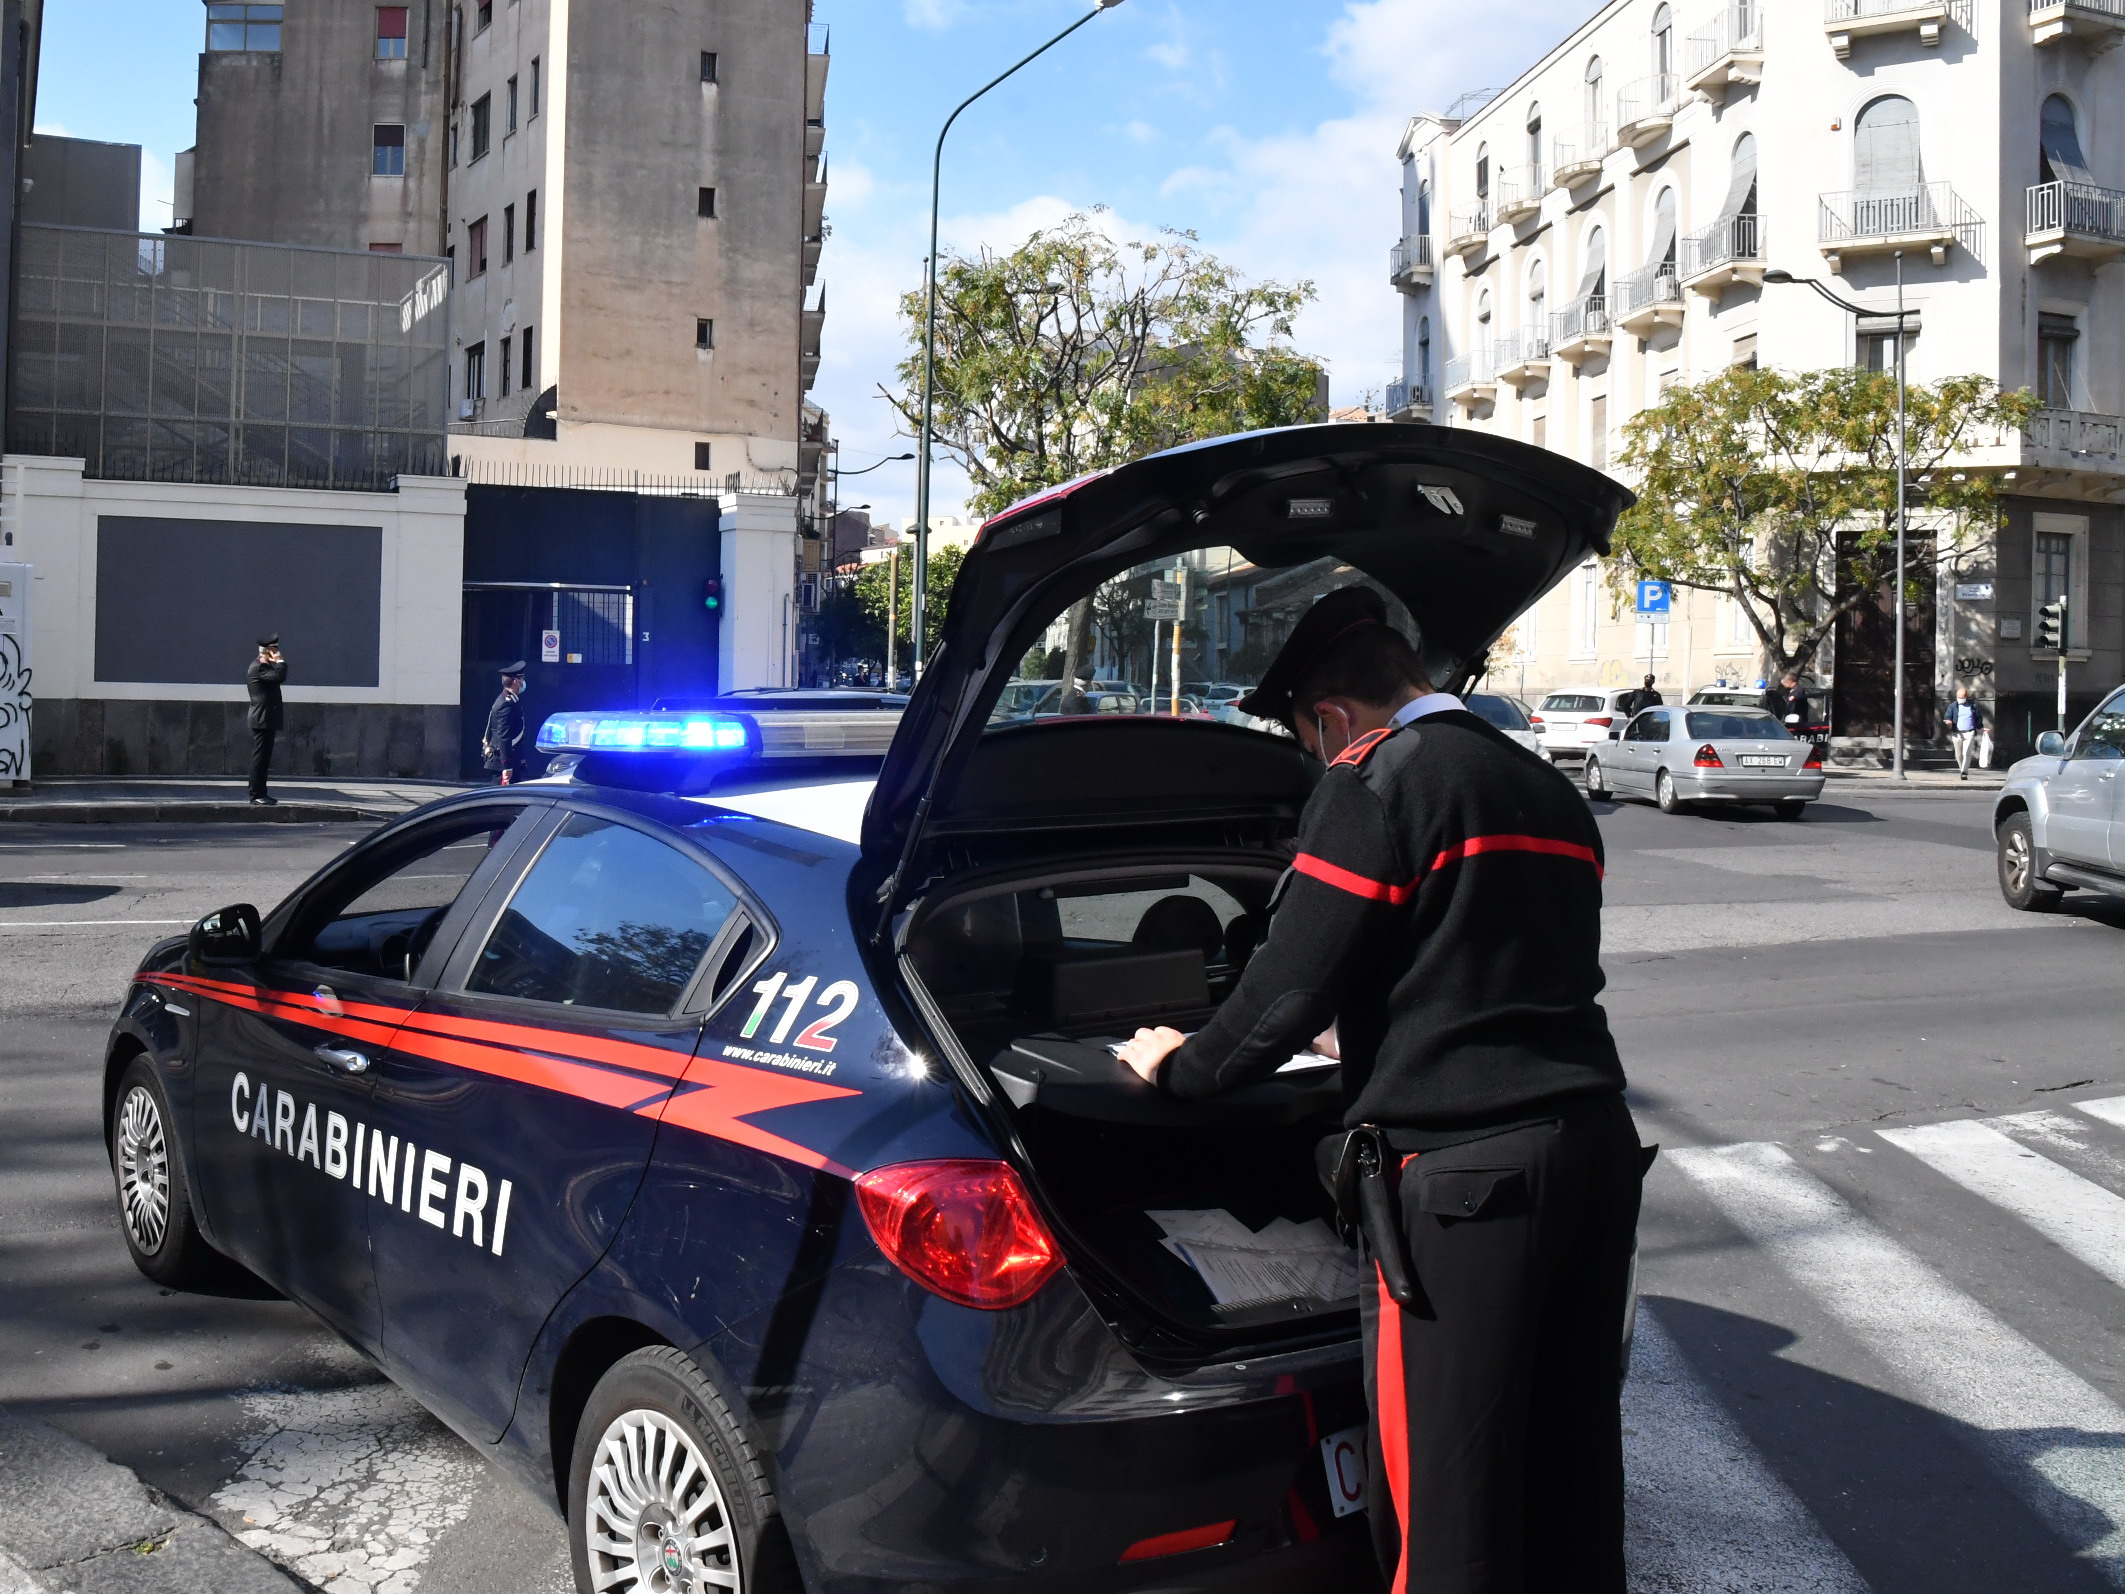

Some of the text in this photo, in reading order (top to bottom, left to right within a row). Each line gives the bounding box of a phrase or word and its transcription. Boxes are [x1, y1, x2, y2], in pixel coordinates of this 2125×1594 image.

[1644, 585, 1662, 608] P
[642, 632, 650, 641] 3
[740, 971, 859, 1053] 112
[722, 1045, 836, 1076] www.carabinieri.it
[231, 1071, 512, 1257] CARABINIERI
